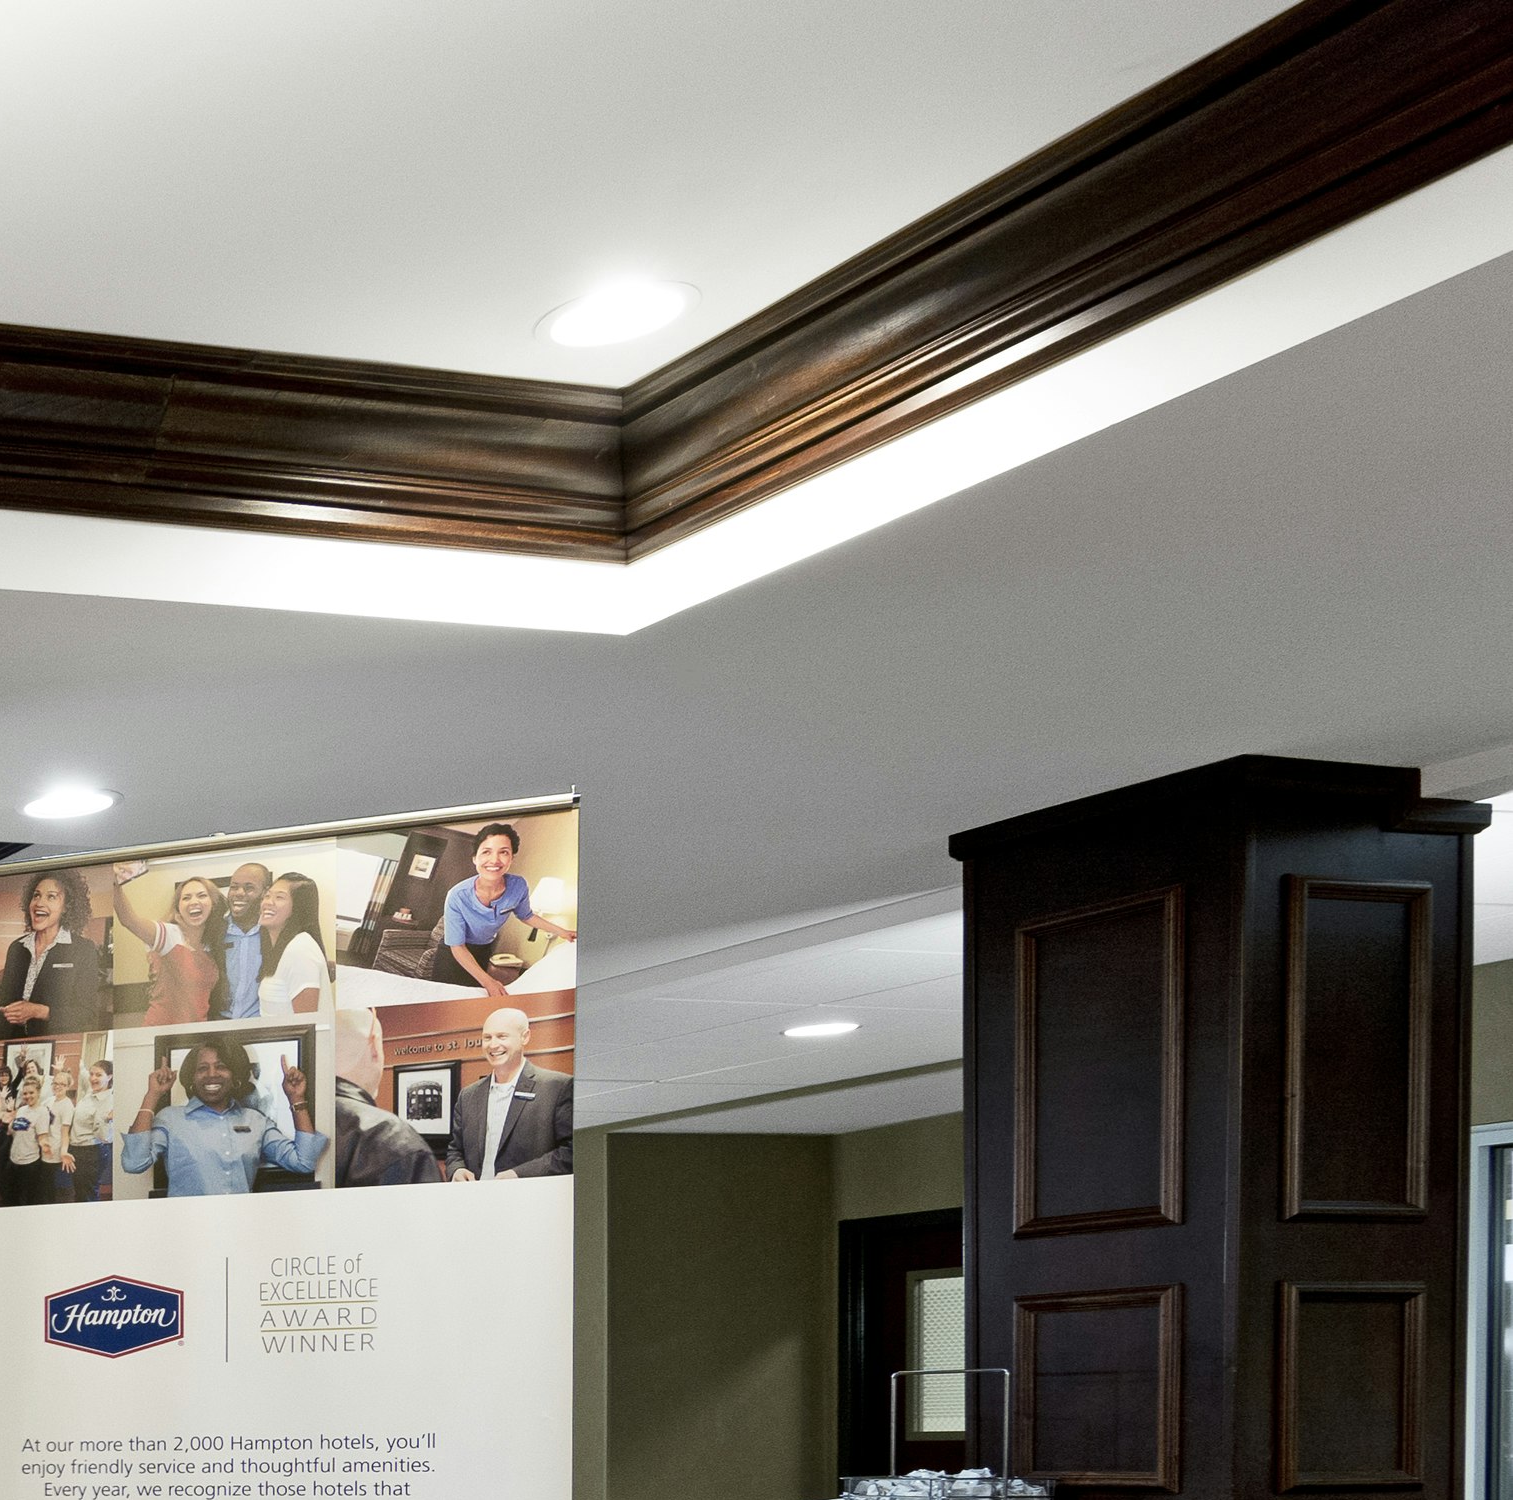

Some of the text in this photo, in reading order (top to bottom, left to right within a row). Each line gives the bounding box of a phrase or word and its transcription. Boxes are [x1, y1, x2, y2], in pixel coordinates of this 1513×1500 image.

[394, 1045, 432, 1055] welcome
[434, 1042, 444, 1052] to
[465, 1038, 484, 1049] lou
[270, 1252, 363, 1277] CIRCLE of
[259, 1278, 378, 1301] EXCELLENCE
[51, 1302, 176, 1333] Hampton
[260, 1306, 377, 1328] AWARD
[261, 1333, 375, 1354] WINNER
[21, 1432, 436, 1455] At our more than 2,000 Hampton hotels, you'll
[21, 1456, 436, 1479] enjoy friendly service and thoughtful amenities.
[44, 1479, 412, 1500] Every year, we recognize those hotels that
